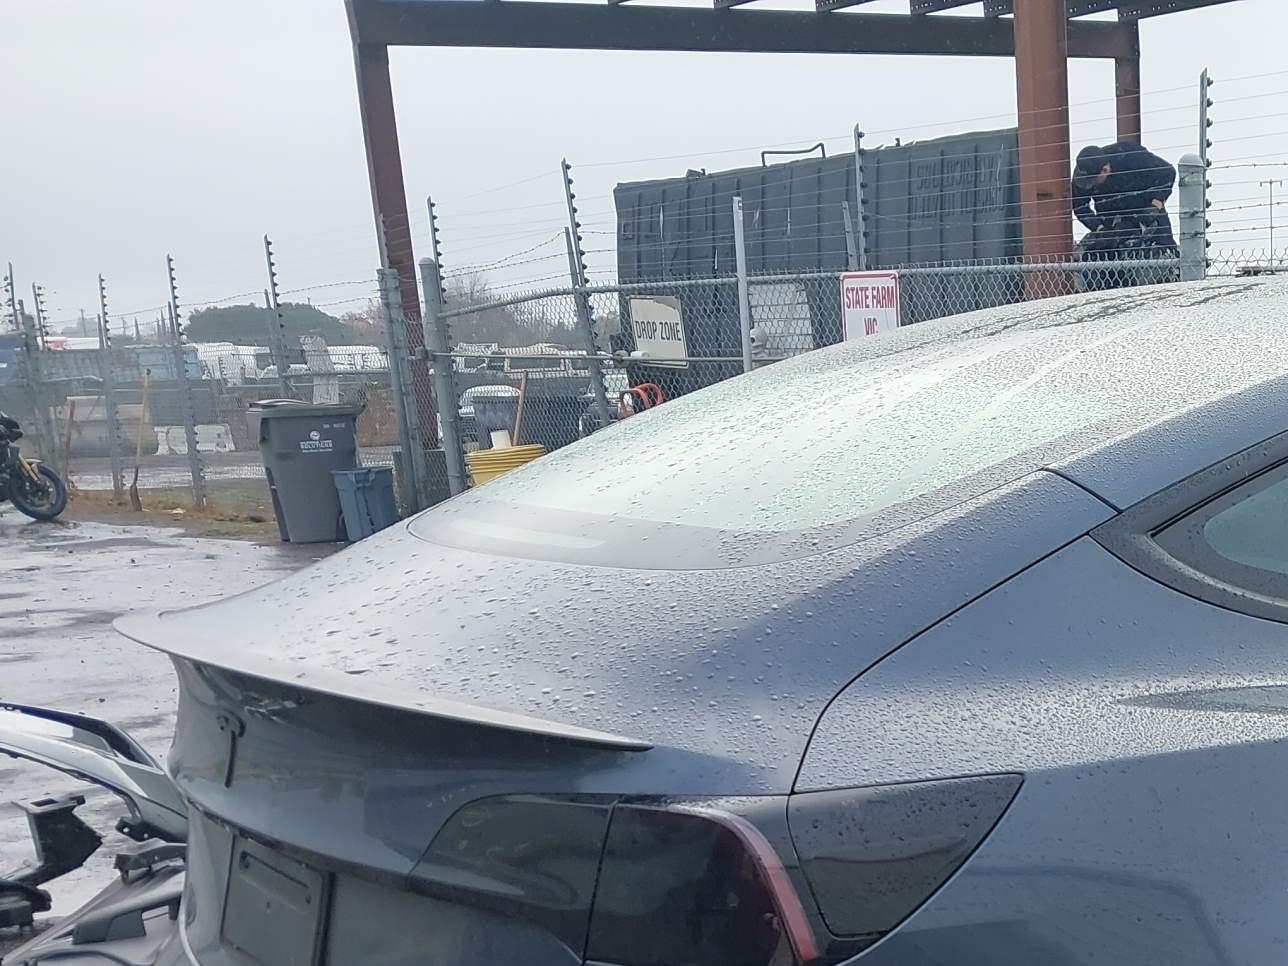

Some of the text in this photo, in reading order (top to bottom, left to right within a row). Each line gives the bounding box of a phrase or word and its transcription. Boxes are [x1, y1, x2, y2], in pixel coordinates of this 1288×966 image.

[845, 285, 896, 310] STATE FARM
[634, 320, 682, 342] DROP ZONE
